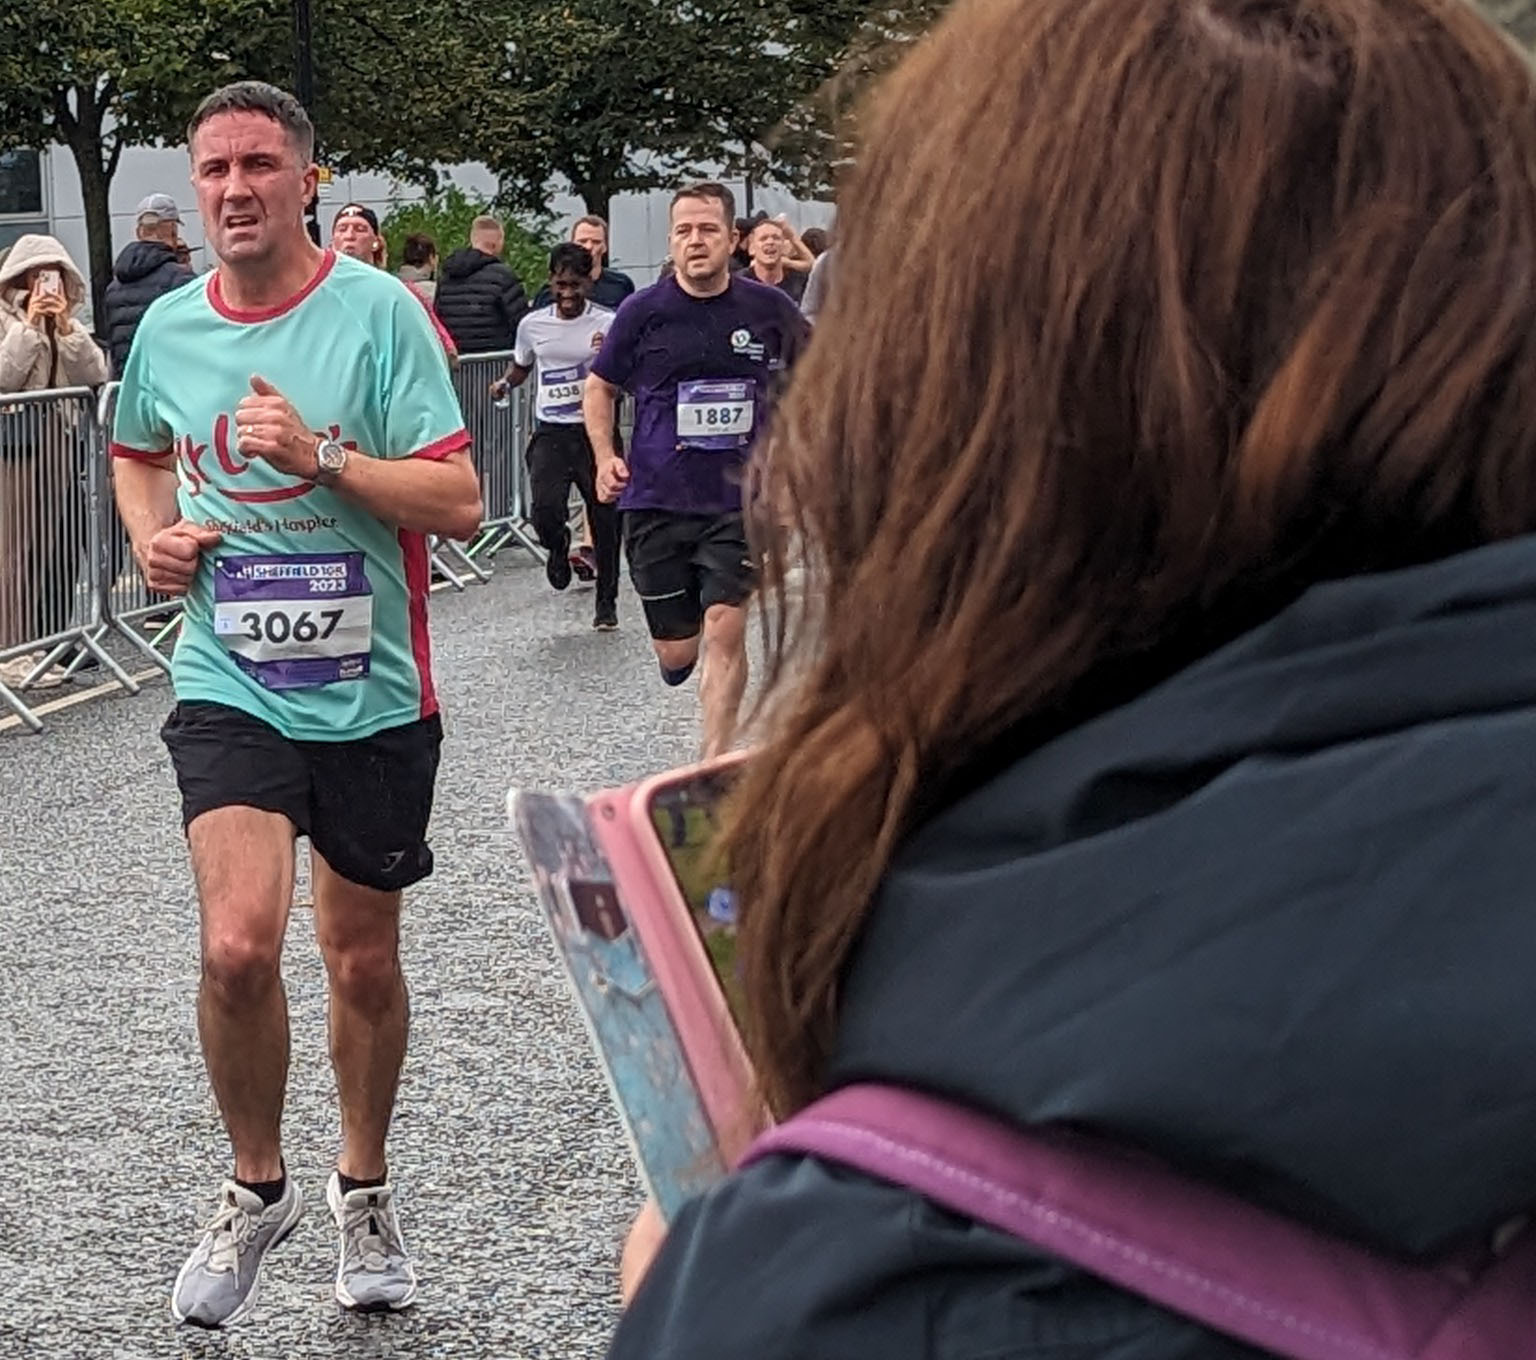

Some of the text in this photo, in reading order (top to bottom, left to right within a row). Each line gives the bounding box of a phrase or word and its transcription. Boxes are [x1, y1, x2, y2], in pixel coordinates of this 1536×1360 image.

[694, 407, 744, 425] 1887
[309, 579, 347, 592] 2023
[241, 609, 345, 643] 3067
